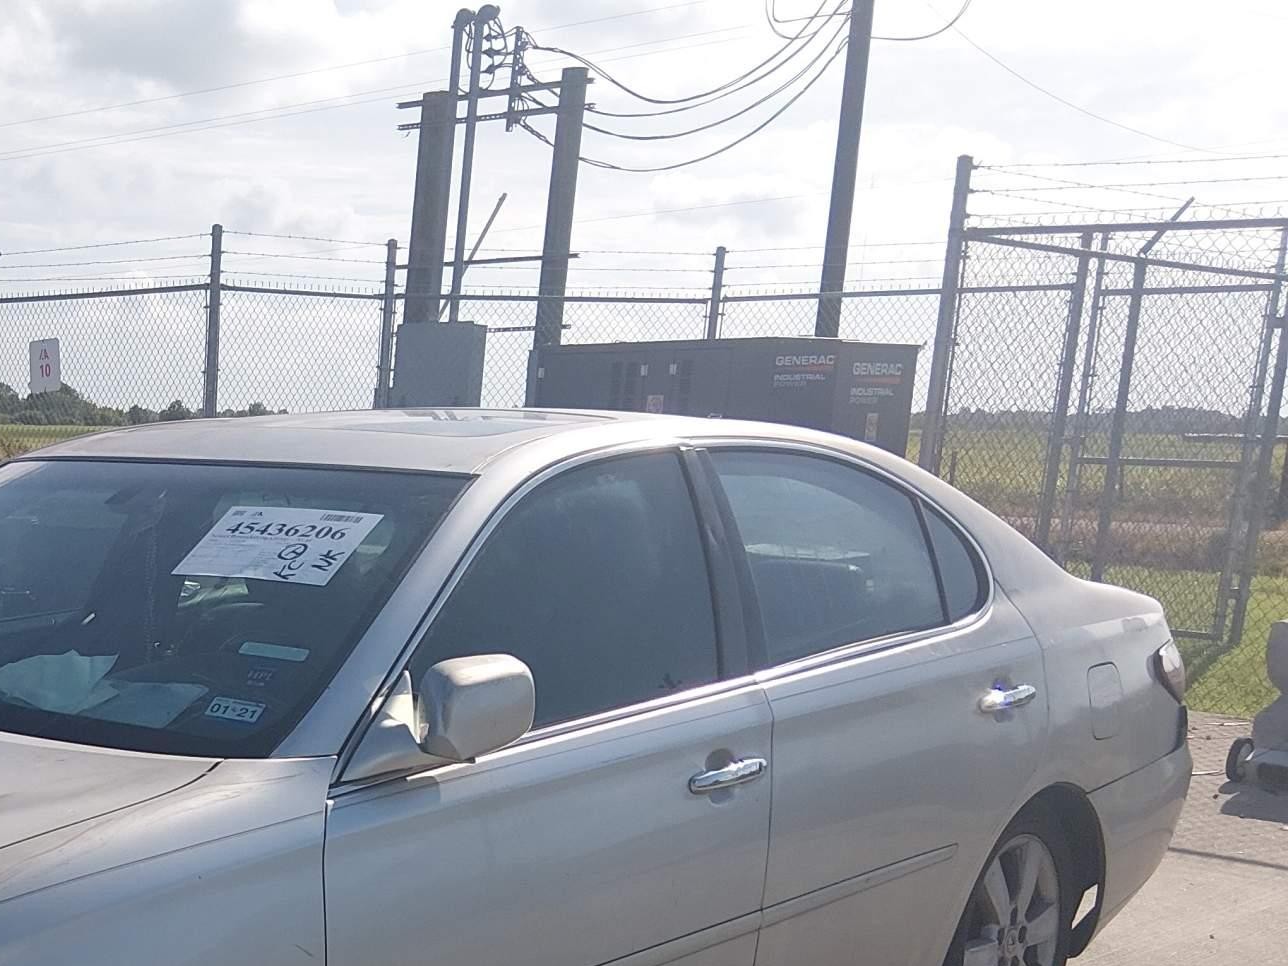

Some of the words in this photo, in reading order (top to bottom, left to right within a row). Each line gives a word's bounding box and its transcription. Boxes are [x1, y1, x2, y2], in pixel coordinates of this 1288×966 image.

[775, 355, 835, 366] GENERAC
[39, 364, 51, 378] 10
[852, 362, 902, 376] GENERAC
[774, 374, 826, 382] INDUSTRIAL
[850, 387, 894, 396] INDUSTRIAL
[226, 521, 351, 541] 45436206
[210, 703, 230, 715] 01
[235, 707, 258, 719] 21
